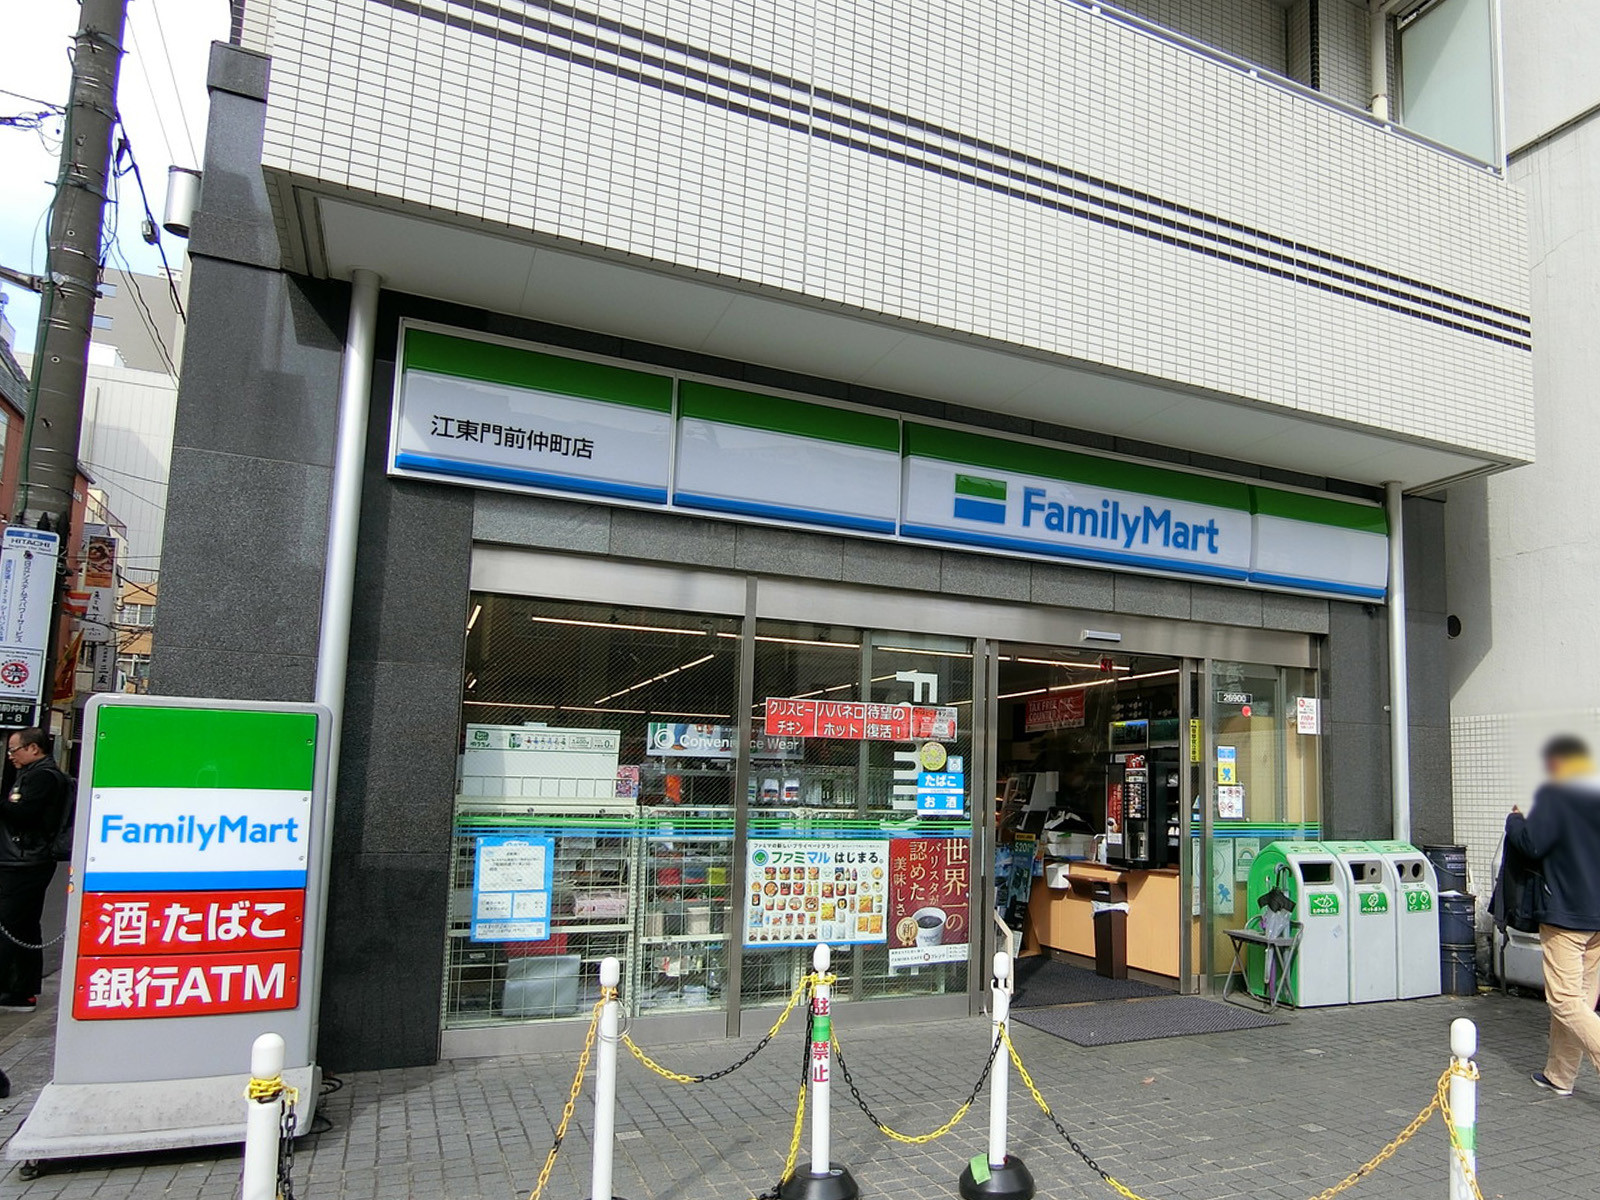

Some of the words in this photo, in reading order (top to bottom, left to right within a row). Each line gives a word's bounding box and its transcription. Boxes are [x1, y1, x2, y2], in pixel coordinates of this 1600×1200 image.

[431, 414, 594, 461] 江東門前仲町店
[1022, 486, 1220, 555] FamilyMart
[11, 538, 51, 548] HITACHI
[1223, 693, 1247, 703] 26900
[769, 701, 814, 717] クリスピー
[818, 703, 865, 720] ハバネロ
[867, 705, 905, 721] 待望の
[777, 720, 805, 735] チキン
[824, 723, 858, 738] ホット
[867, 723, 902, 739] 復活！
[679, 733, 764, 749] Convenice
[767, 738, 799, 750] Wear
[924, 774, 957, 787] たばこ
[100, 815, 298, 851] FamilyMart
[771, 851, 831, 864] ファミマル
[909, 841, 927, 901] 認めた
[929, 842, 942, 906] バリスタが
[942, 838, 968, 932] 世界一の
[98, 900, 286, 946] 酒・たばこ
[902, 923, 914, 935] 新
[88, 963, 286, 1010] 銀行ATM
[812, 998, 830, 1082] 駐禁止
